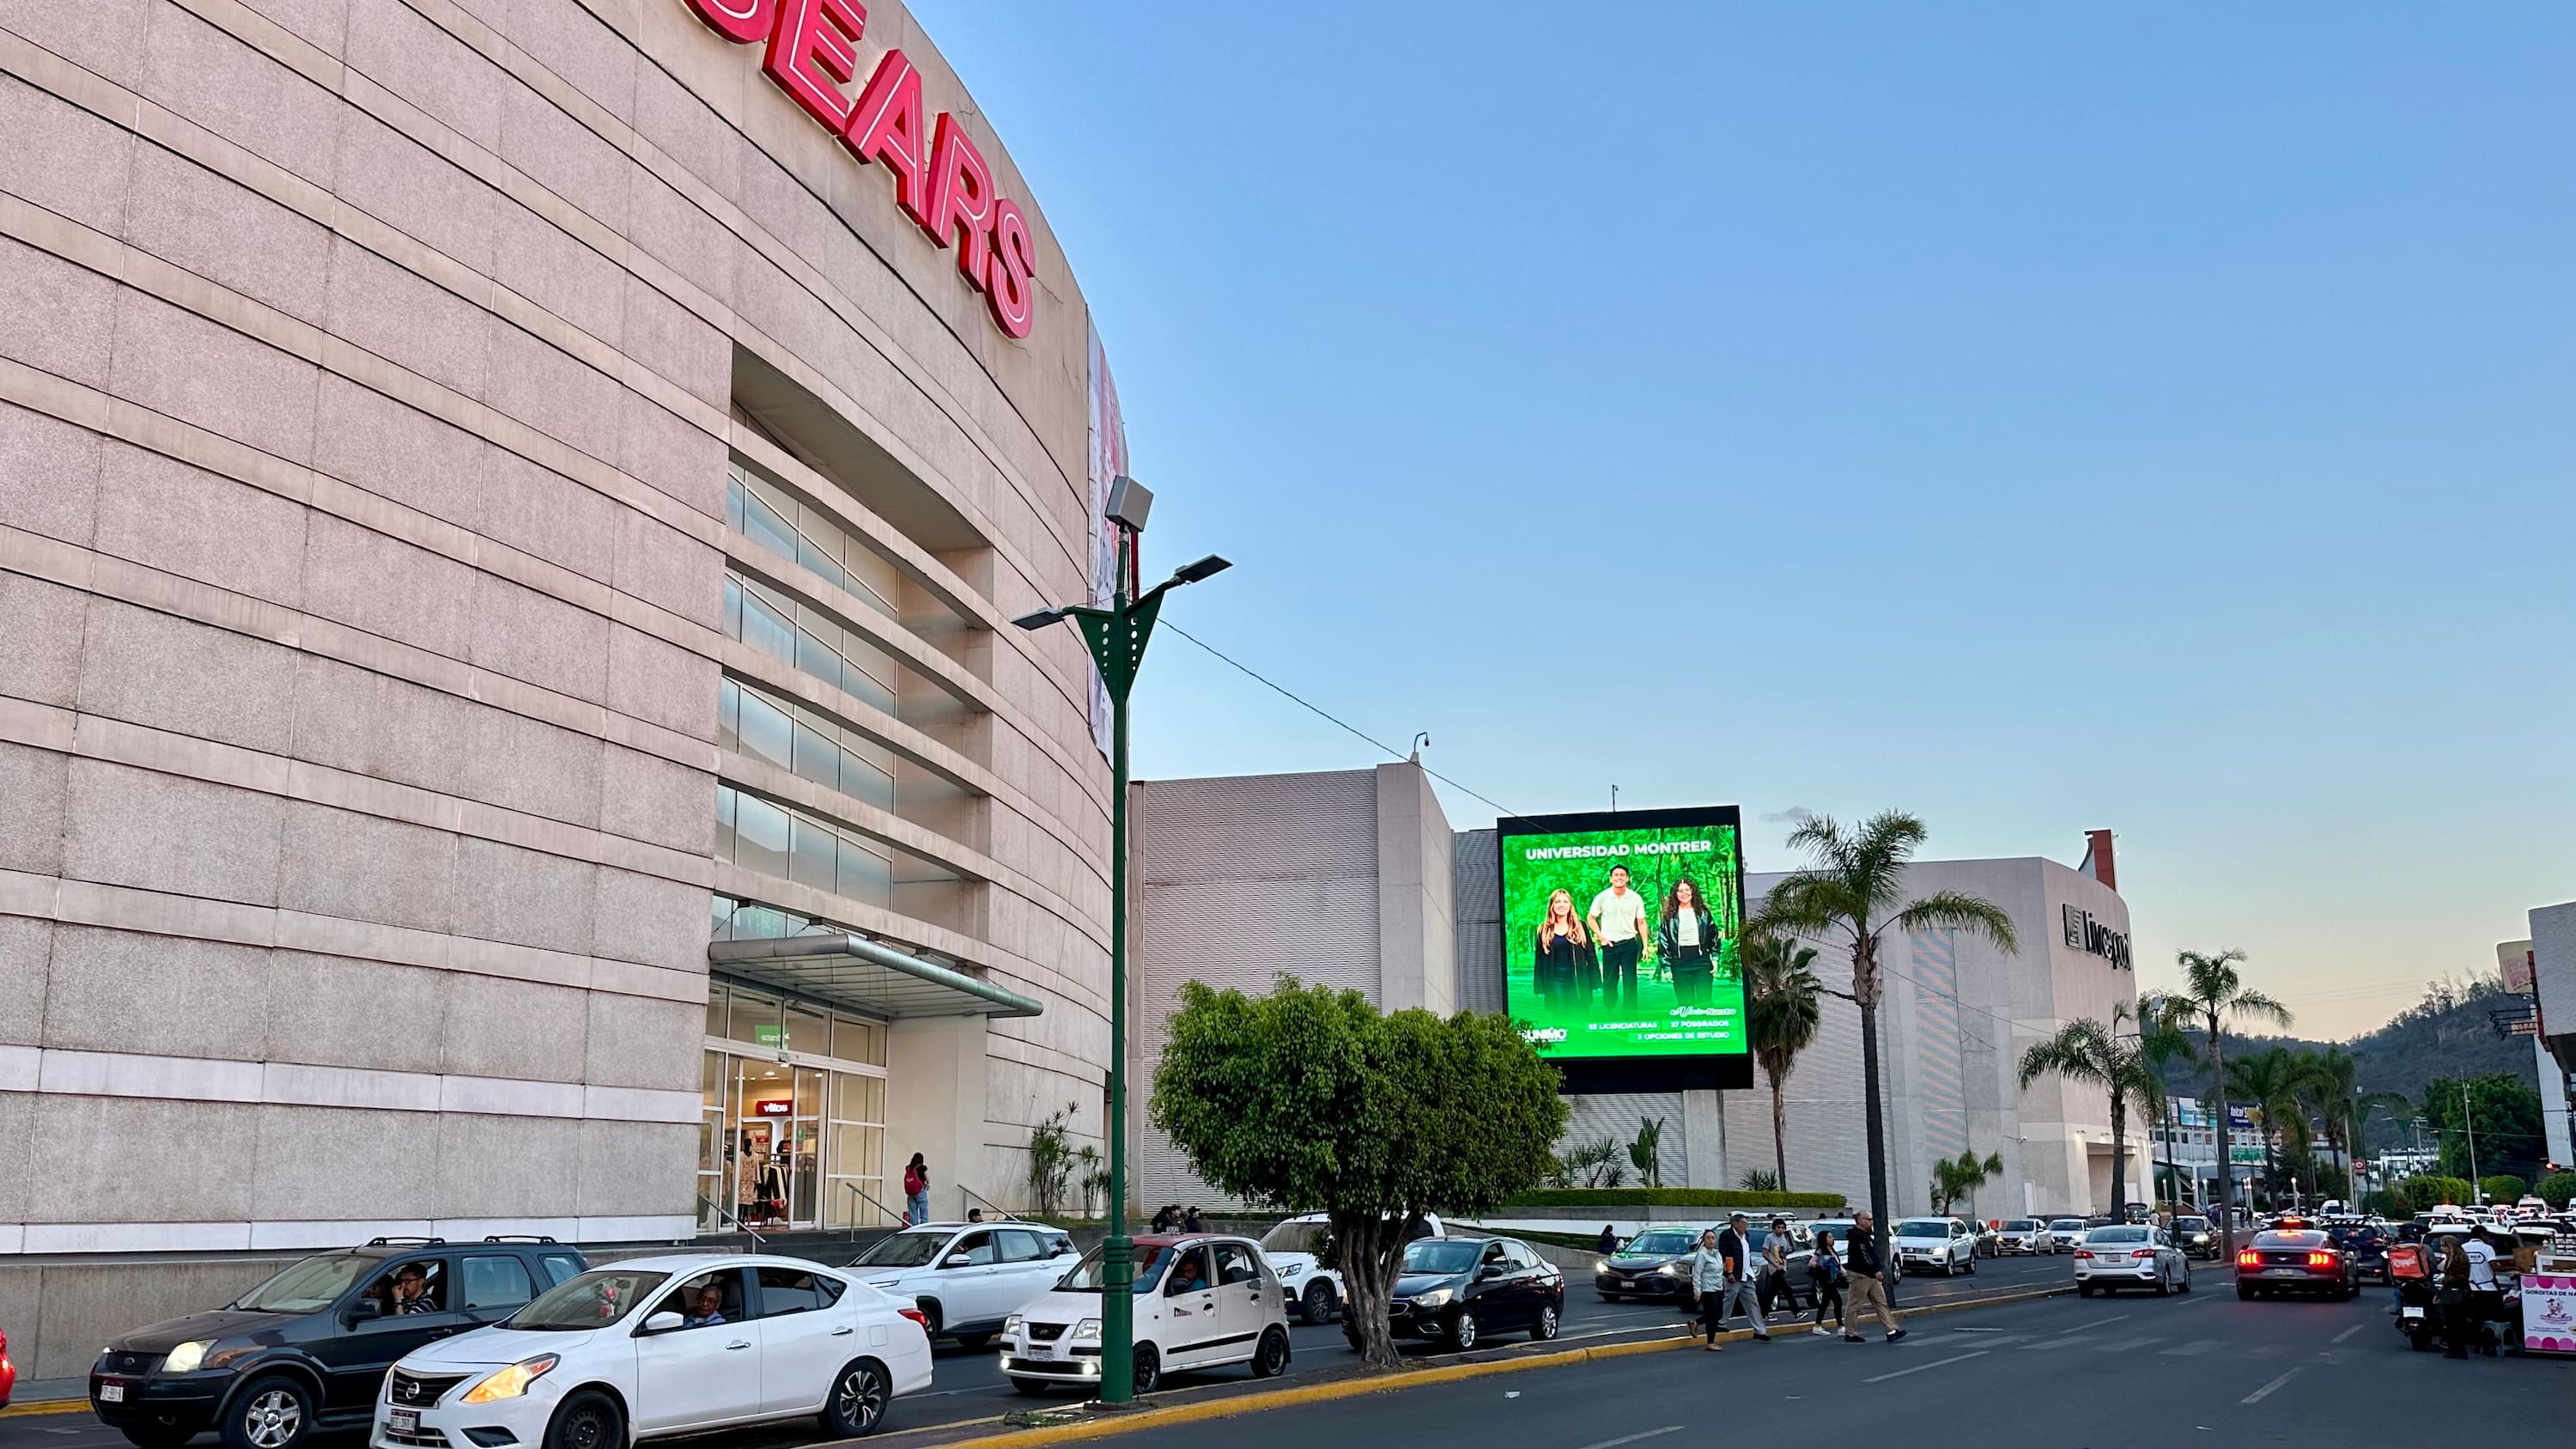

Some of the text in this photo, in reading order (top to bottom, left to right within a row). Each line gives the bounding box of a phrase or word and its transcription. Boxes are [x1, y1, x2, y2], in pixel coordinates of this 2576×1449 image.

[683, 0, 1036, 339] EARS
[1526, 840, 1712, 860] UNIVERSIDAD MONTRER
[1599, 1021, 1657, 1030] LICENCIATURAS
